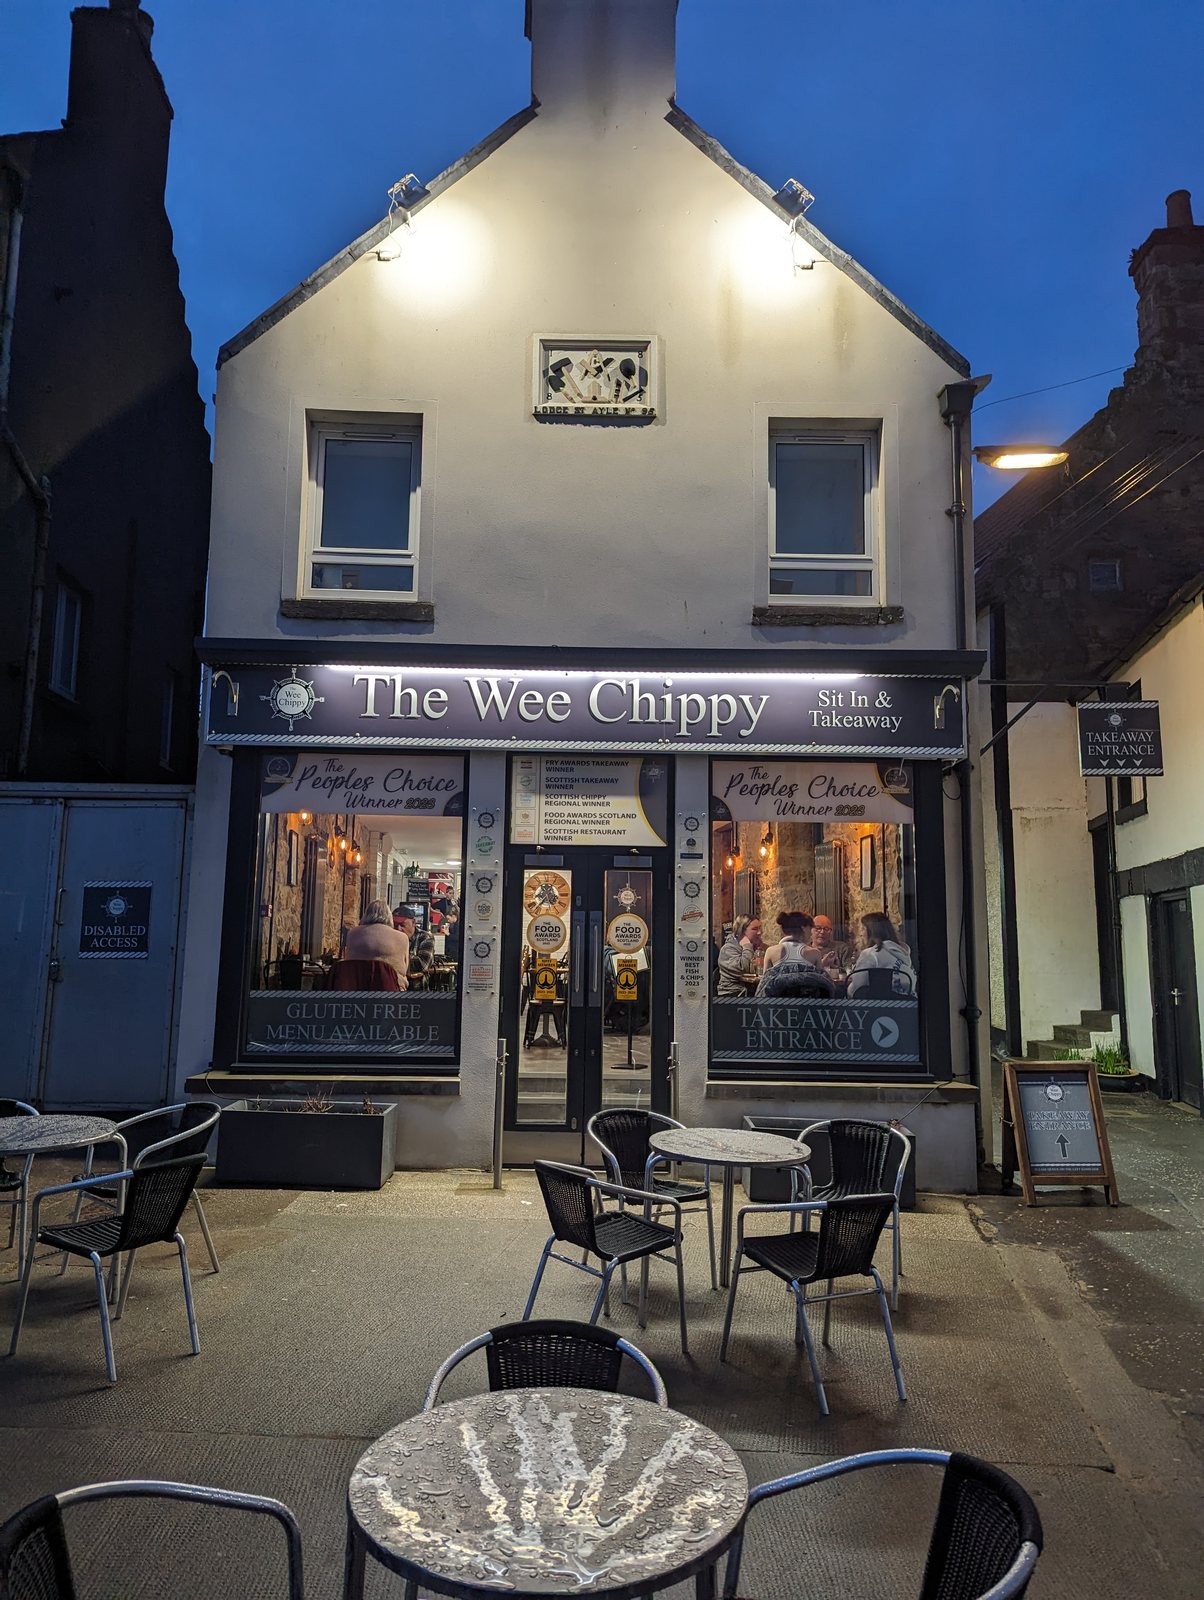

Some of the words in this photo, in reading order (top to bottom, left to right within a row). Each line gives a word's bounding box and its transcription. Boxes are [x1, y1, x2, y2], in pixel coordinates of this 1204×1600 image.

[592, 407, 619, 415] AYLE
[279, 699, 305, 708] Chippy
[353, 673, 449, 720] The
[464, 676, 572, 722] Wee
[588, 678, 770, 738] Chippy
[818, 690, 844, 708] Sit
[850, 691, 869, 708] In
[875, 691, 893, 708] &
[808, 710, 903, 733] Takeaway
[1085, 731, 1154, 743] TAKEAWAY
[1088, 744, 1156, 755] ENTRANCE
[323, 758, 345, 773] The
[560, 759, 591, 767] AWARDS
[748, 765, 769, 780] The
[295, 764, 375, 799] Peoples
[383, 768, 458, 793] Choice
[723, 772, 800, 805] Peoples
[807, 775, 881, 799] Choice
[343, 791, 404, 809] Winner
[773, 799, 833, 816] Winner
[84, 925, 146, 936] DISABLED
[90, 937, 138, 948] ACCESS
[286, 1002, 367, 1020] GLUTEN
[373, 1003, 422, 1020] FREE
[736, 1007, 869, 1030] TAKEAWAY
[266, 1024, 324, 1040] MENU
[330, 1024, 440, 1042] AVAILABLE
[745, 1030, 863, 1050] ENTRANCE
[1027, 1110, 1090, 1121] TAKEAWAY
[1029, 1121, 1092, 1131] ENTRANCE
